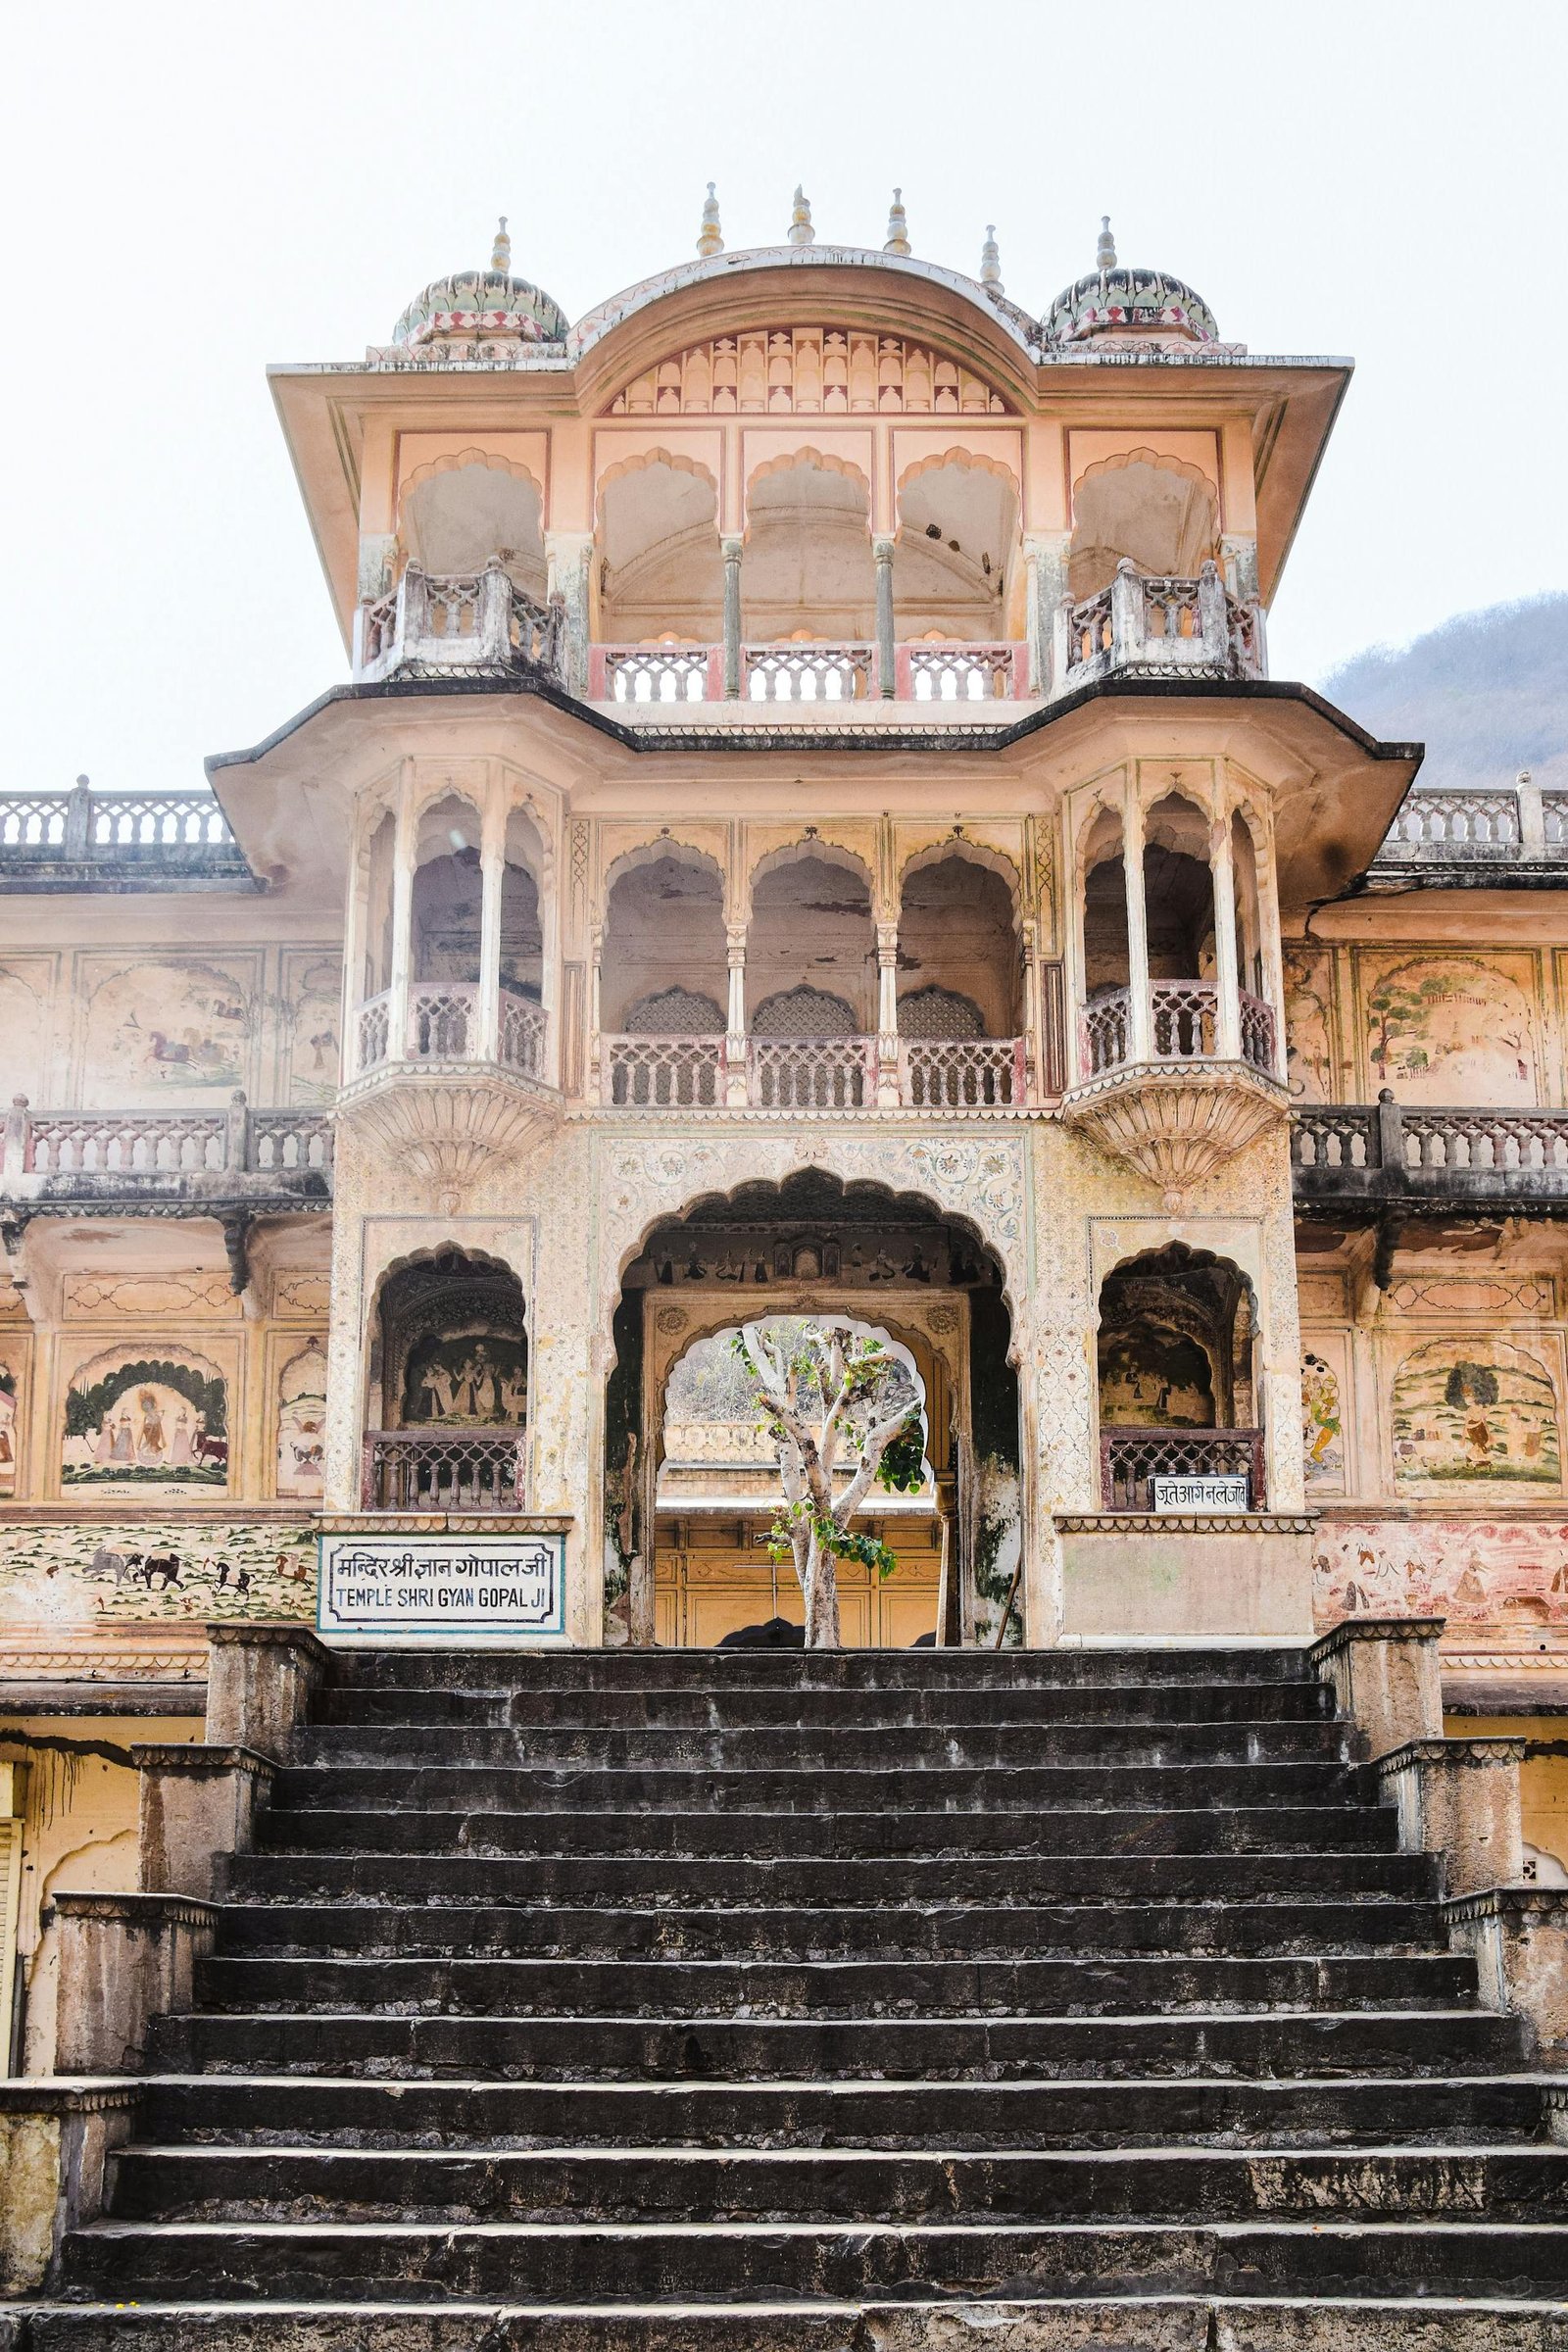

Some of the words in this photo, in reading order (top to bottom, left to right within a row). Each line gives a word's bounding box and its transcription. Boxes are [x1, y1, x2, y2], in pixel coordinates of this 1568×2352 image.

[1156, 1481, 1179, 1505] जूते
[1179, 1481, 1204, 1504] आगे
[1205, 1486, 1216, 1504] न
[1216, 1481, 1229, 1504] ले
[338, 1552, 390, 1579] मन्दिर
[389, 1553, 415, 1577] श्री
[415, 1559, 454, 1579] ज्ञान
[456, 1553, 523, 1577] गोपाल
[522, 1553, 547, 1577] जी
[336, 1589, 392, 1607] TEMPLE
[397, 1589, 433, 1607] SHRI
[438, 1589, 473, 1607] GYAN
[479, 1589, 528, 1607] GOPAL
[531, 1589, 545, 1607] JI
